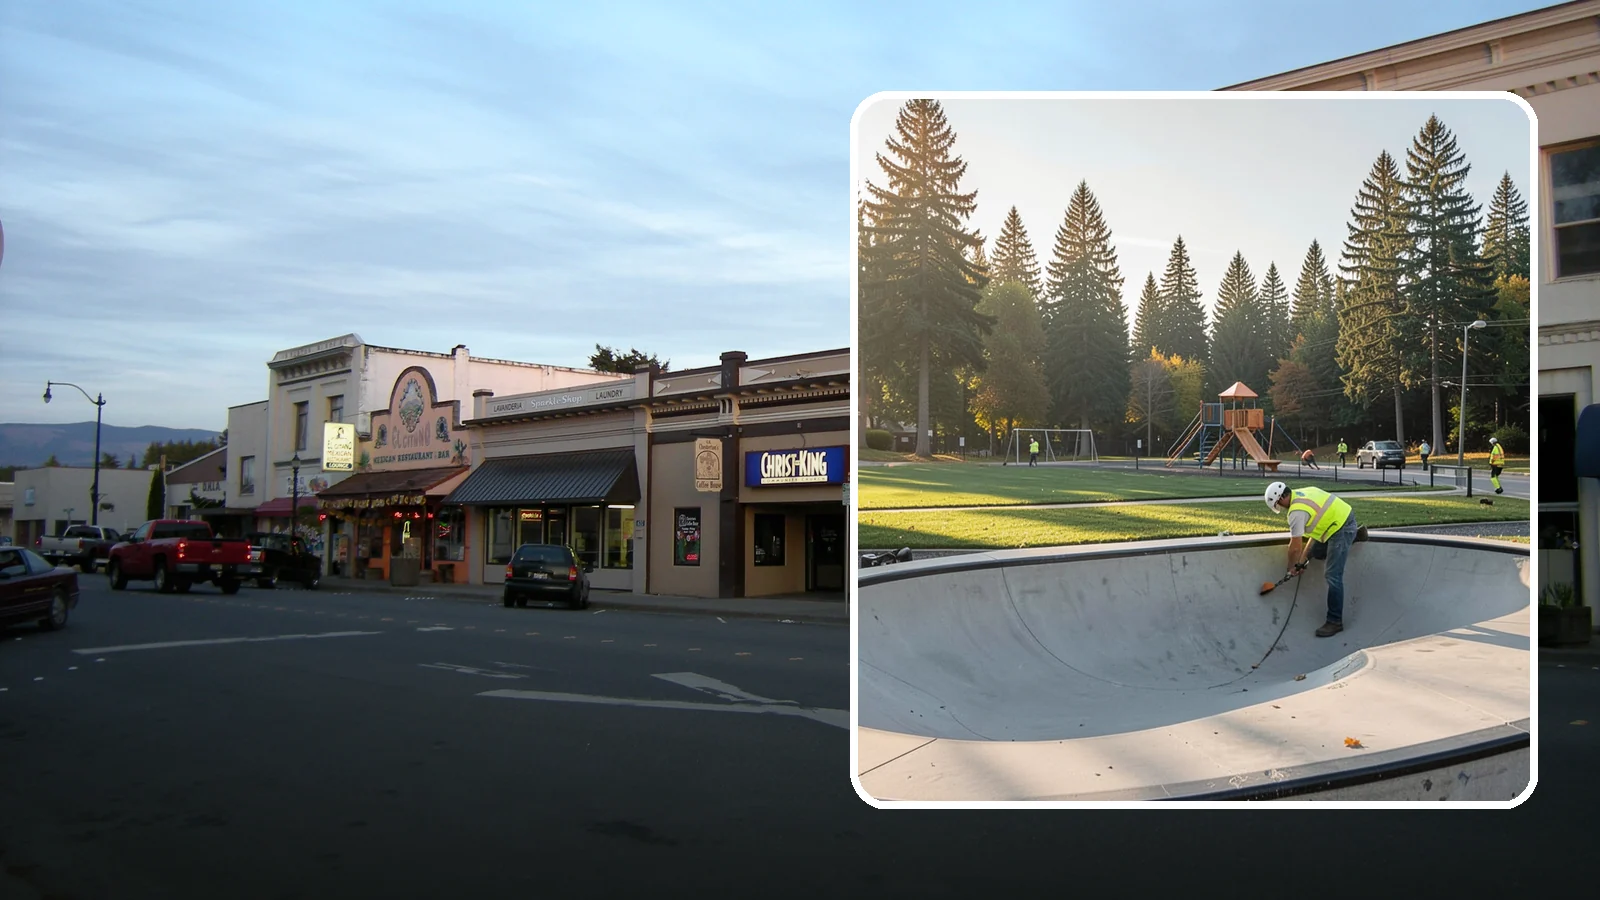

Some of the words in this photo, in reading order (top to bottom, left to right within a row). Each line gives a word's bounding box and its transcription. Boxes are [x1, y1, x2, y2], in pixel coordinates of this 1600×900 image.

[494, 402, 522, 412] LAVANDERIA
[562, 395, 582, 405] Shop
[596, 389, 623, 399] LAUNDRY
[374, 455, 396, 464] MEXICAN
[398, 451, 433, 462] RESTAURANT
[438, 450, 450, 459] BAR
[761, 452, 797, 477] CHRIST
[799, 450, 827, 476] KING
